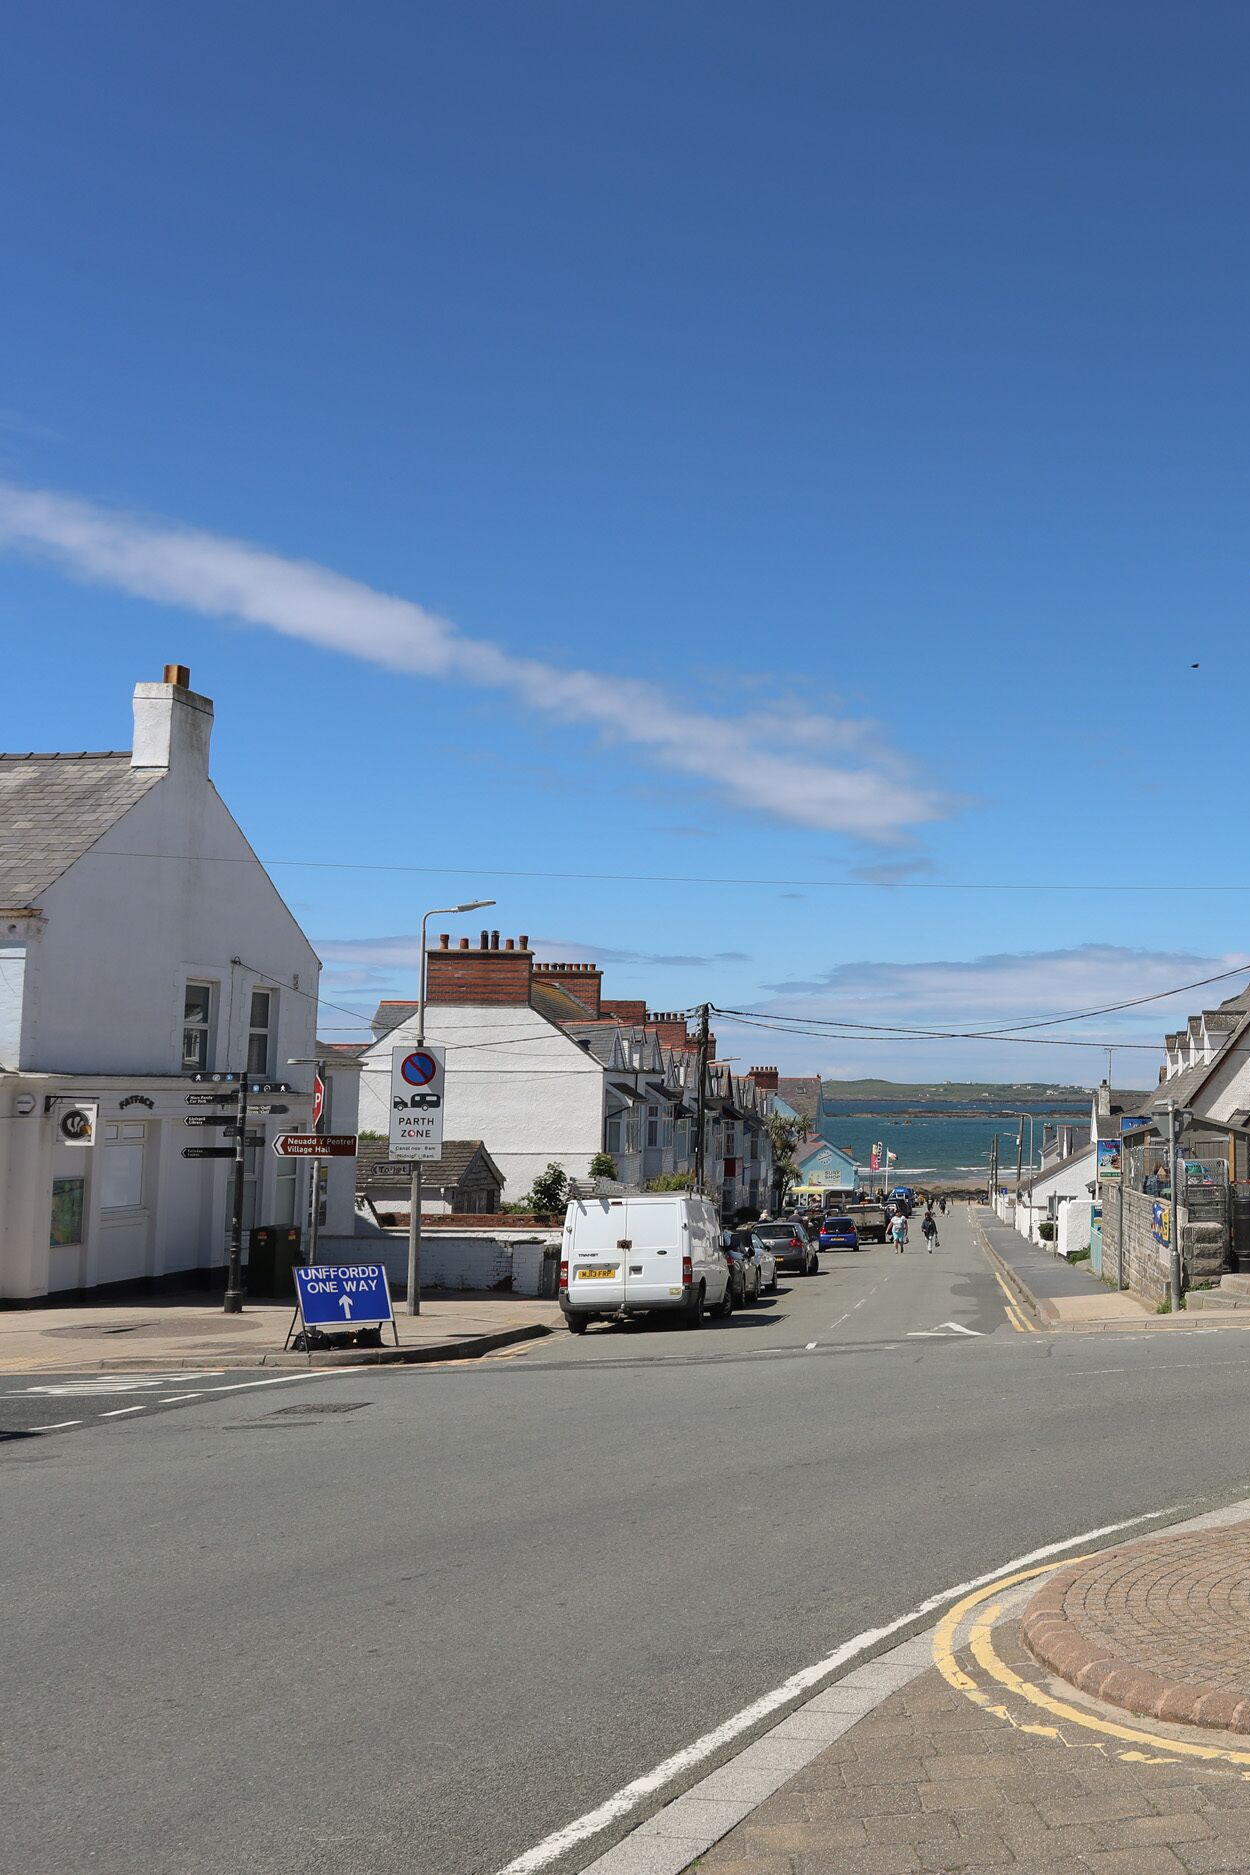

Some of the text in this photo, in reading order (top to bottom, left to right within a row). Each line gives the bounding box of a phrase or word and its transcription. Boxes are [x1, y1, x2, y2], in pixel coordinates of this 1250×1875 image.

[119, 1095, 155, 1110] FATFACE
[398, 1117, 434, 1126] PARTH
[401, 1129, 431, 1138] ZONE
[287, 1137, 317, 1145] Neuadd
[326, 1137, 355, 1145] Pentref
[287, 1146, 313, 1154] Village
[300, 1266, 379, 1280] UNFFORDD
[307, 1280, 377, 1294] ONE WAY
